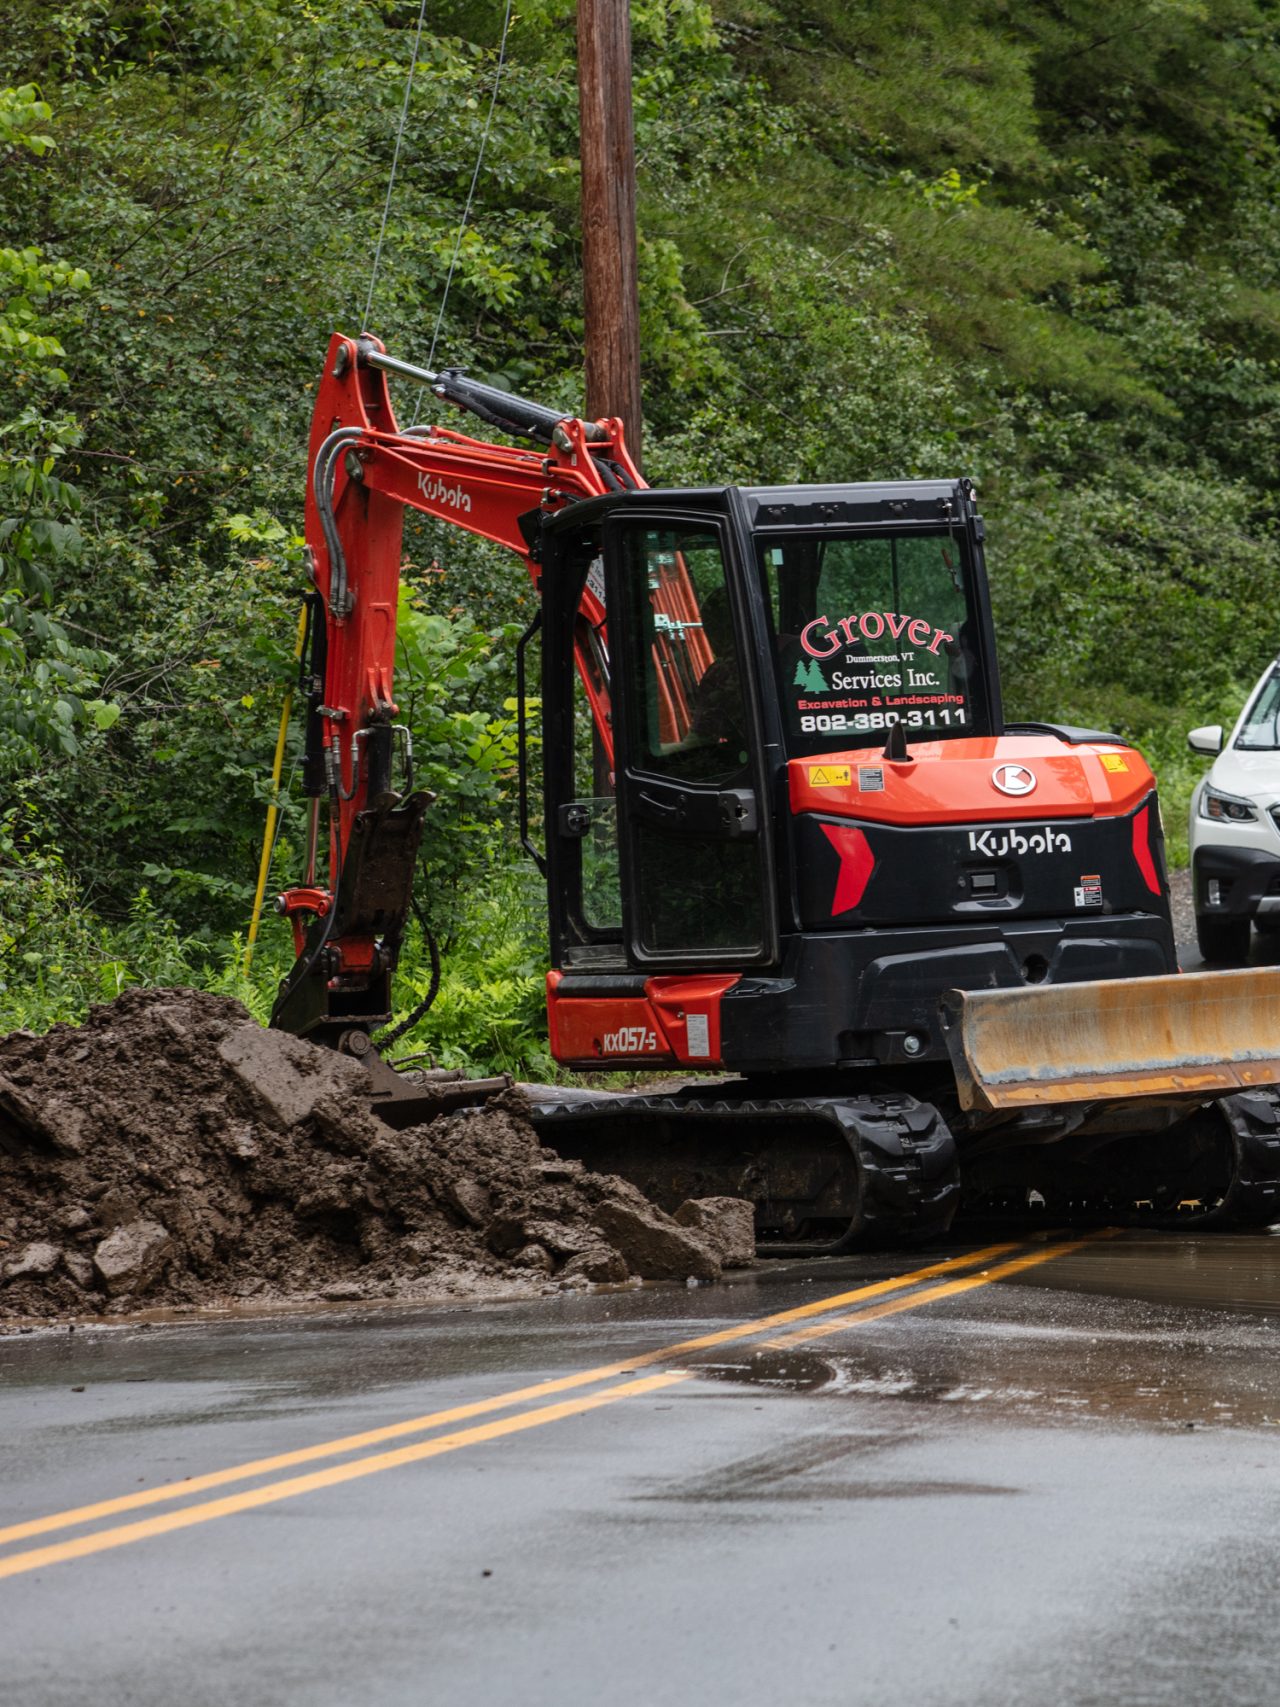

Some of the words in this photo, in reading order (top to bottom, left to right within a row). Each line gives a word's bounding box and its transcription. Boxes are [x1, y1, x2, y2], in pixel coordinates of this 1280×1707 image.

[418, 471, 471, 513] Kubota
[800, 612, 954, 657] Grover
[900, 652, 914, 661] VT
[832, 670, 902, 690] Services
[907, 668, 940, 687] Inc.
[797, 698, 868, 710] Excavation
[871, 696, 882, 706] &
[885, 693, 964, 705] Landscaping
[800, 708, 966, 732] 802-380-3111
[968, 827, 1072, 857] Kubota
